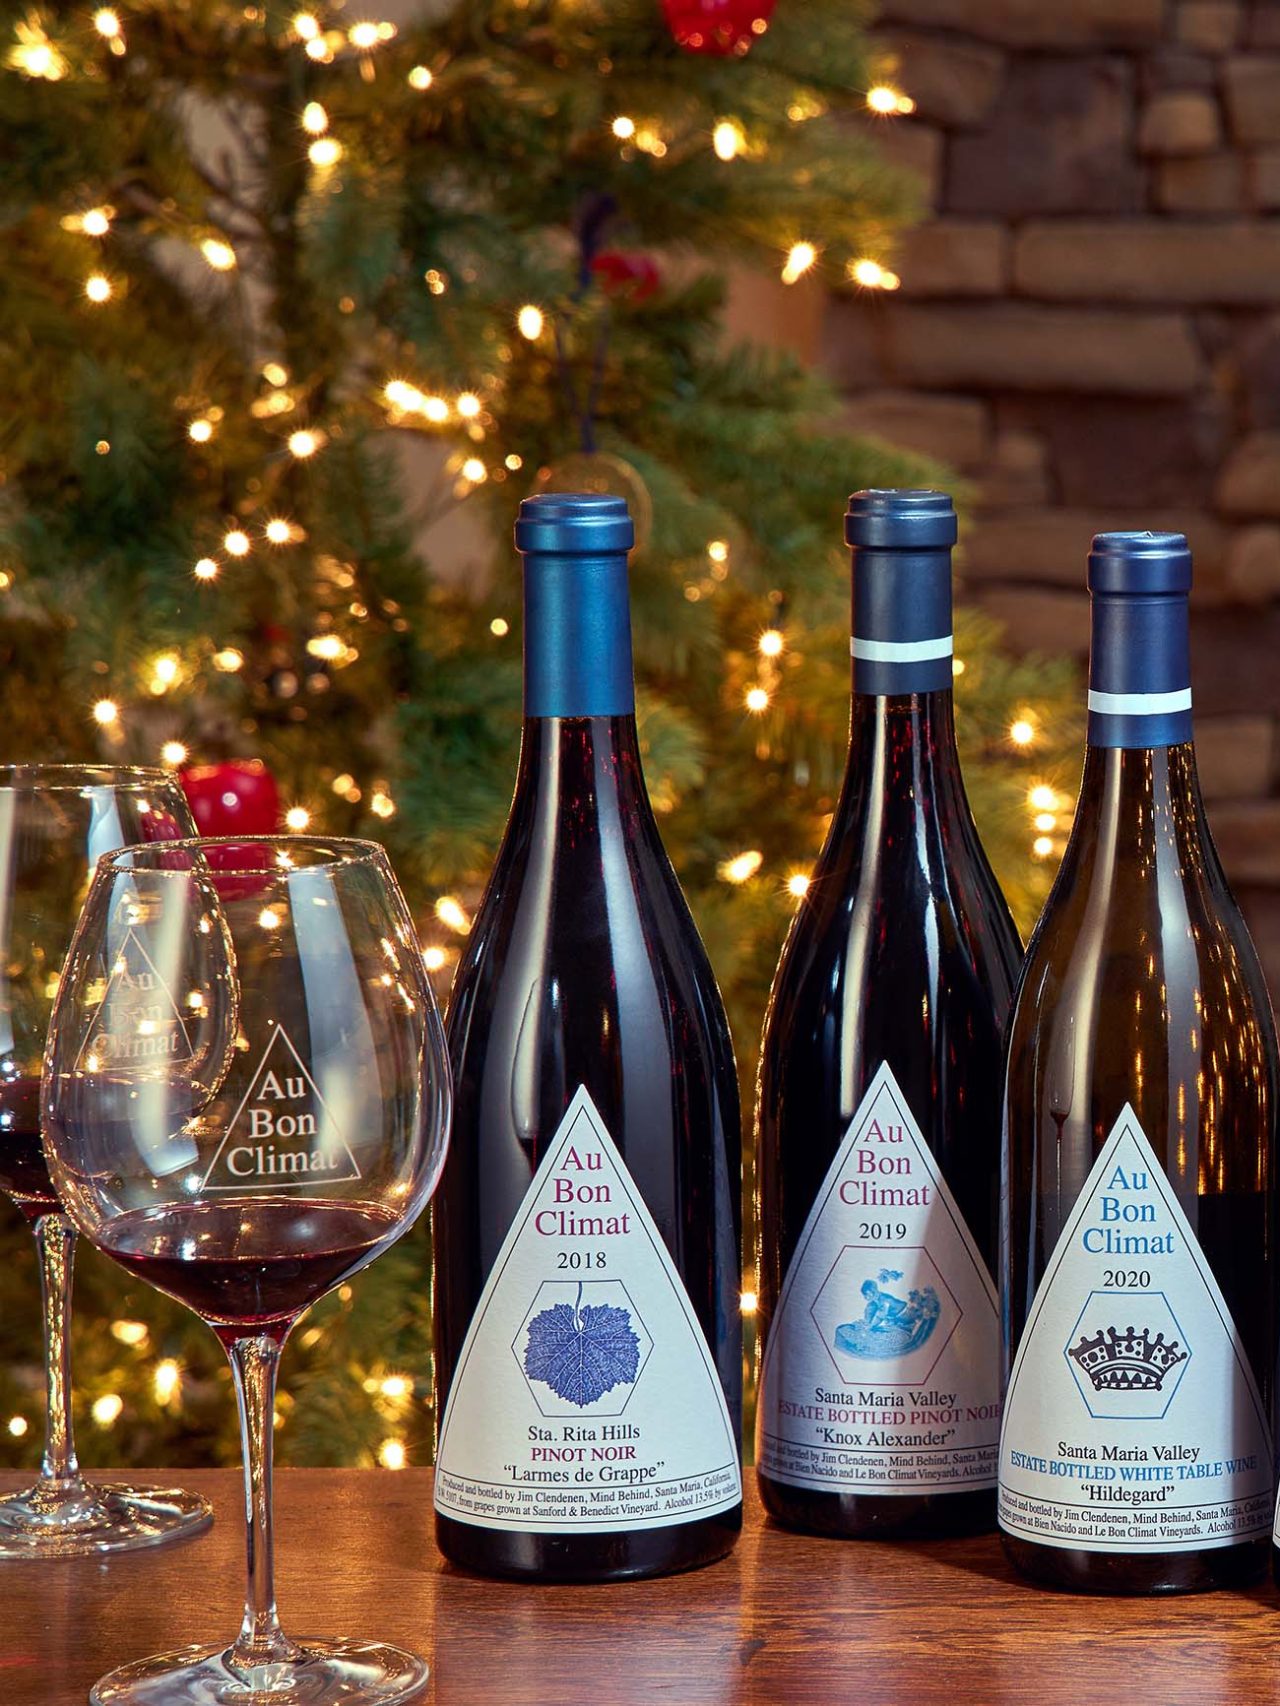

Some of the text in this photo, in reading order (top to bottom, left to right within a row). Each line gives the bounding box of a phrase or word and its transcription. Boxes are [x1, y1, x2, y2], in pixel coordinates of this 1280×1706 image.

[257, 1070, 307, 1100] Au
[248, 1109, 317, 1138] Bon
[863, 1118, 904, 1143] Au
[227, 1145, 338, 1176] Climat
[560, 1145, 603, 1171] Au
[856, 1150, 912, 1175] Bon
[1107, 1165, 1148, 1190] Au
[553, 1178, 612, 1203] Bon
[839, 1180, 930, 1206] Climat
[1100, 1197, 1156, 1222] Bon
[534, 1210, 631, 1236] Climat
[859, 1222, 907, 1240] 2019
[1082, 1228, 1175, 1254] Climat
[557, 1251, 607, 1269] 2018
[1103, 1270, 1151, 1287] 2020
[815, 1387, 957, 1409] Santa Maria Valley
[779, 1400, 824, 1420] ESTATE
[828, 1409, 905, 1425] BOTTLED
[910, 1408, 962, 1425] PINOT
[527, 1424, 640, 1441] Sta. Rita Hills
[816, 1426, 956, 1446] “Knox Alexander”
[531, 1446, 637, 1462] PINOT NOIR
[889, 1456, 913, 1467] Mind
[1058, 1441, 1200, 1462] Santa Maria Valley
[503, 1461, 665, 1483] “Larmes de Grappe”
[1011, 1450, 1046, 1472] ESTATE
[1049, 1461, 1116, 1480] BOTTLED
[1120, 1467, 1173, 1481] WHITE
[1176, 1462, 1223, 1480] TABLE
[1225, 1456, 1257, 1474] WINE
[478, 1487, 615, 1504] bottled Jim Clendenen, Mind
[580, 1494, 693, 1516] Benedict Alcohol
[1081, 1484, 1175, 1505] “Hildegard”
[1128, 1521, 1236, 1537] Climat Alcohol
[1133, 1513, 1157, 1524] Mind
